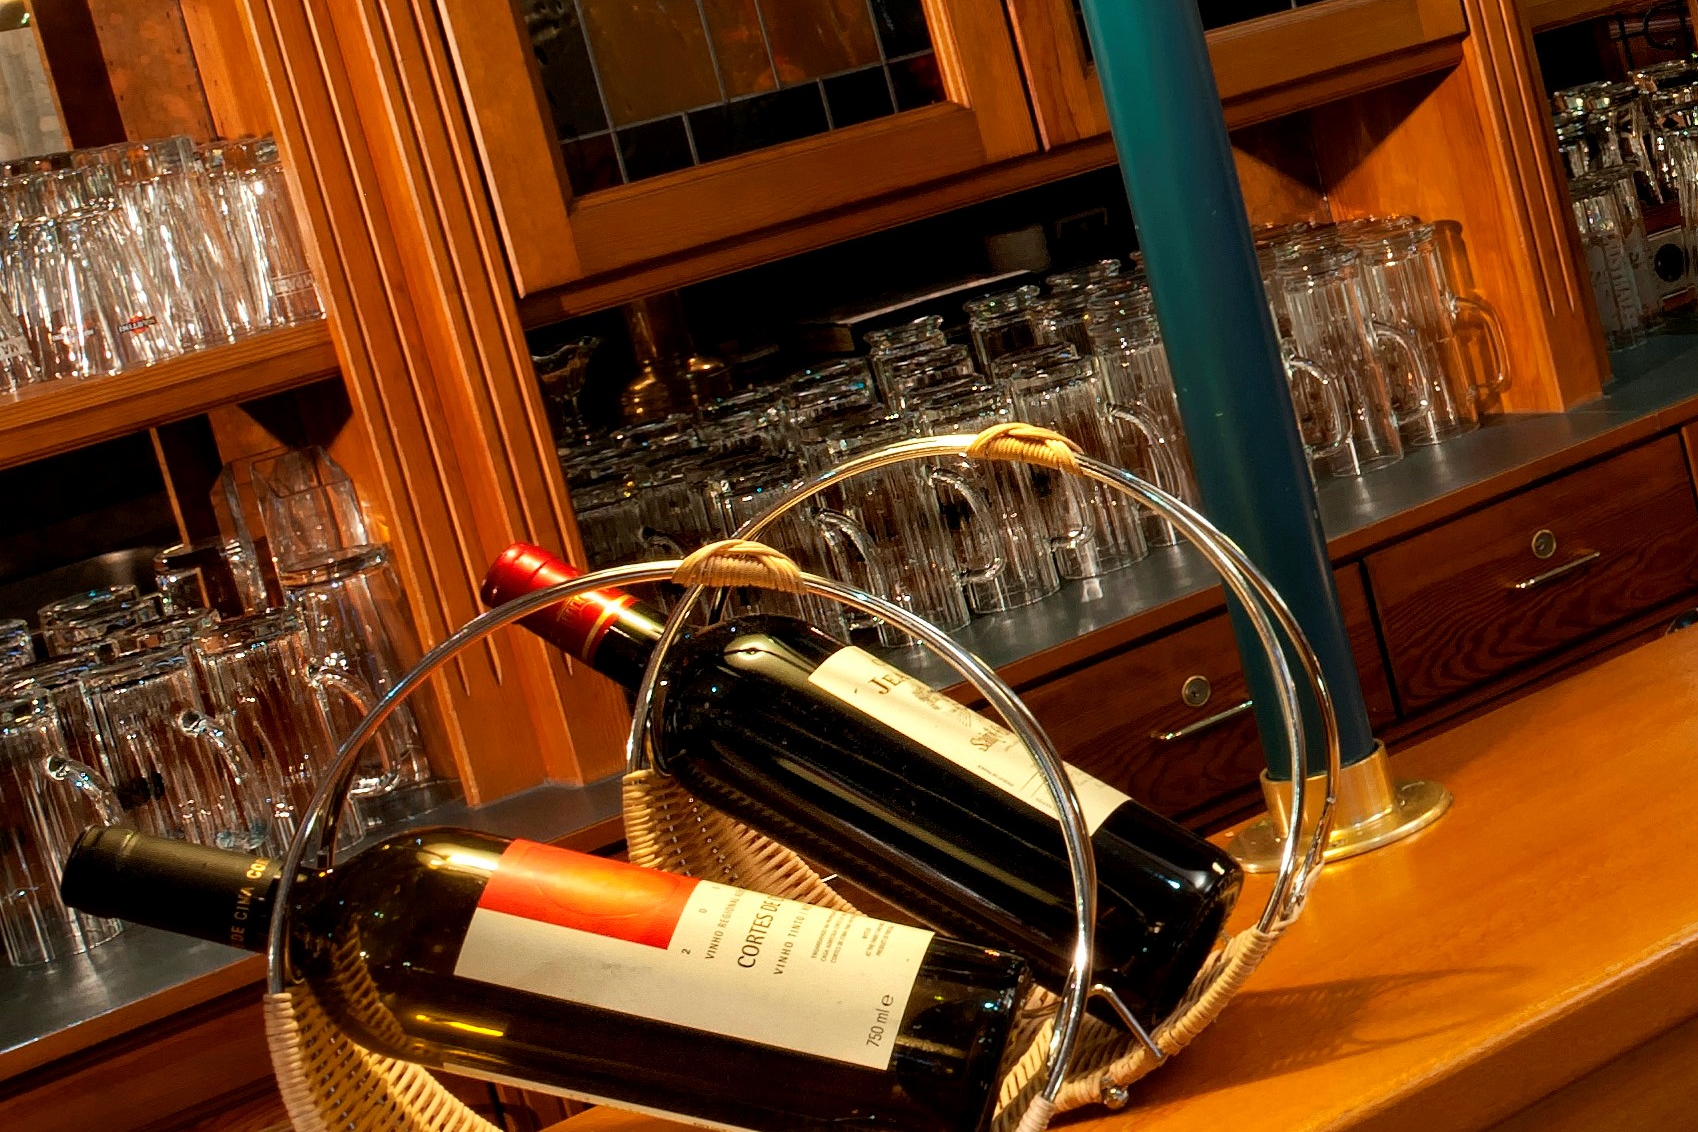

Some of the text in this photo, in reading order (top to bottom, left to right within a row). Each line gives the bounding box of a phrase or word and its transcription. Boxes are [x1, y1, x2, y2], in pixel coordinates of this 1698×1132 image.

[705, 930, 724, 960] VINHO
[737, 913, 774, 968] CORTES
[760, 900, 781, 913] DE
[773, 915, 805, 975] VINHO TINTO
[866, 1025, 884, 1047] 750
[875, 1008, 890, 1024] ml
